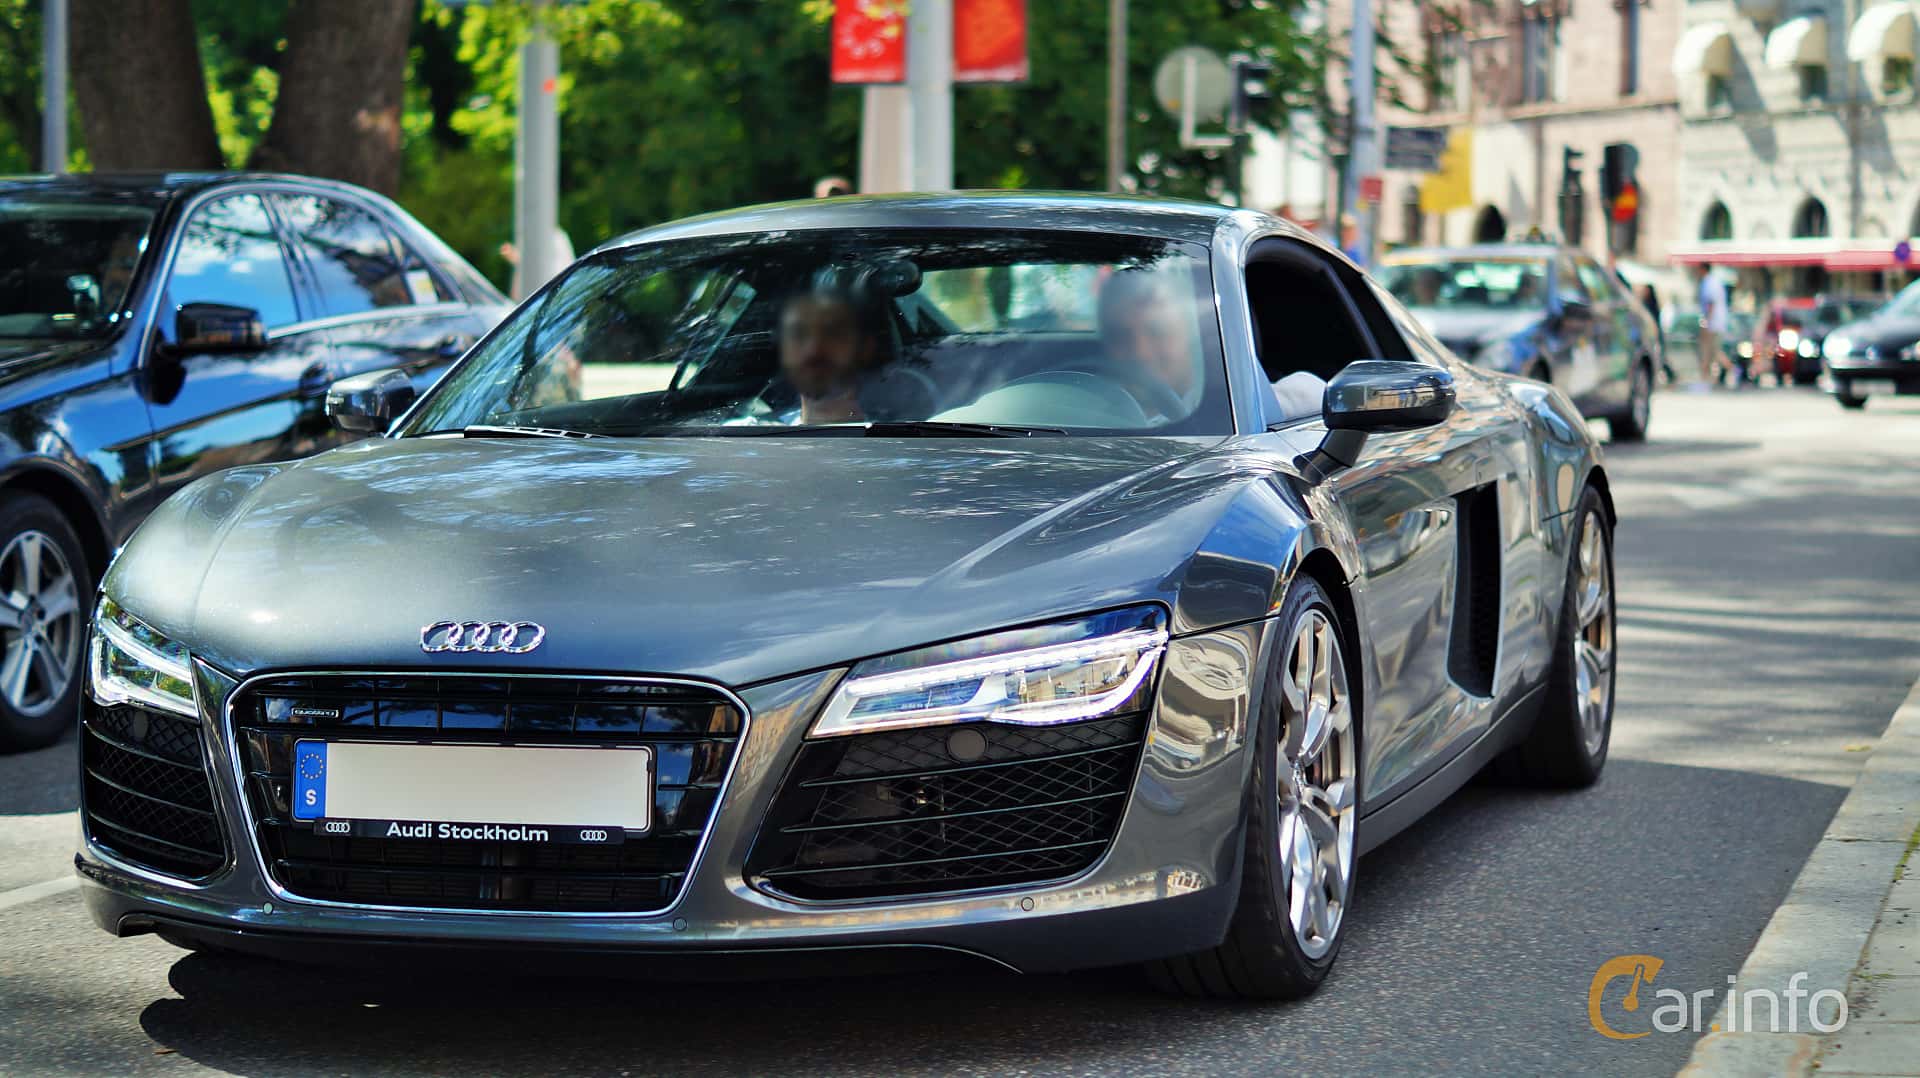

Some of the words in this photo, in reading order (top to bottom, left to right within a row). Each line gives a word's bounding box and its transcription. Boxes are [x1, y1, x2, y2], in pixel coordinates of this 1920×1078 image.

[305, 789, 317, 806] S
[386, 822, 432, 838] Audi
[438, 823, 549, 842] Stockholm
